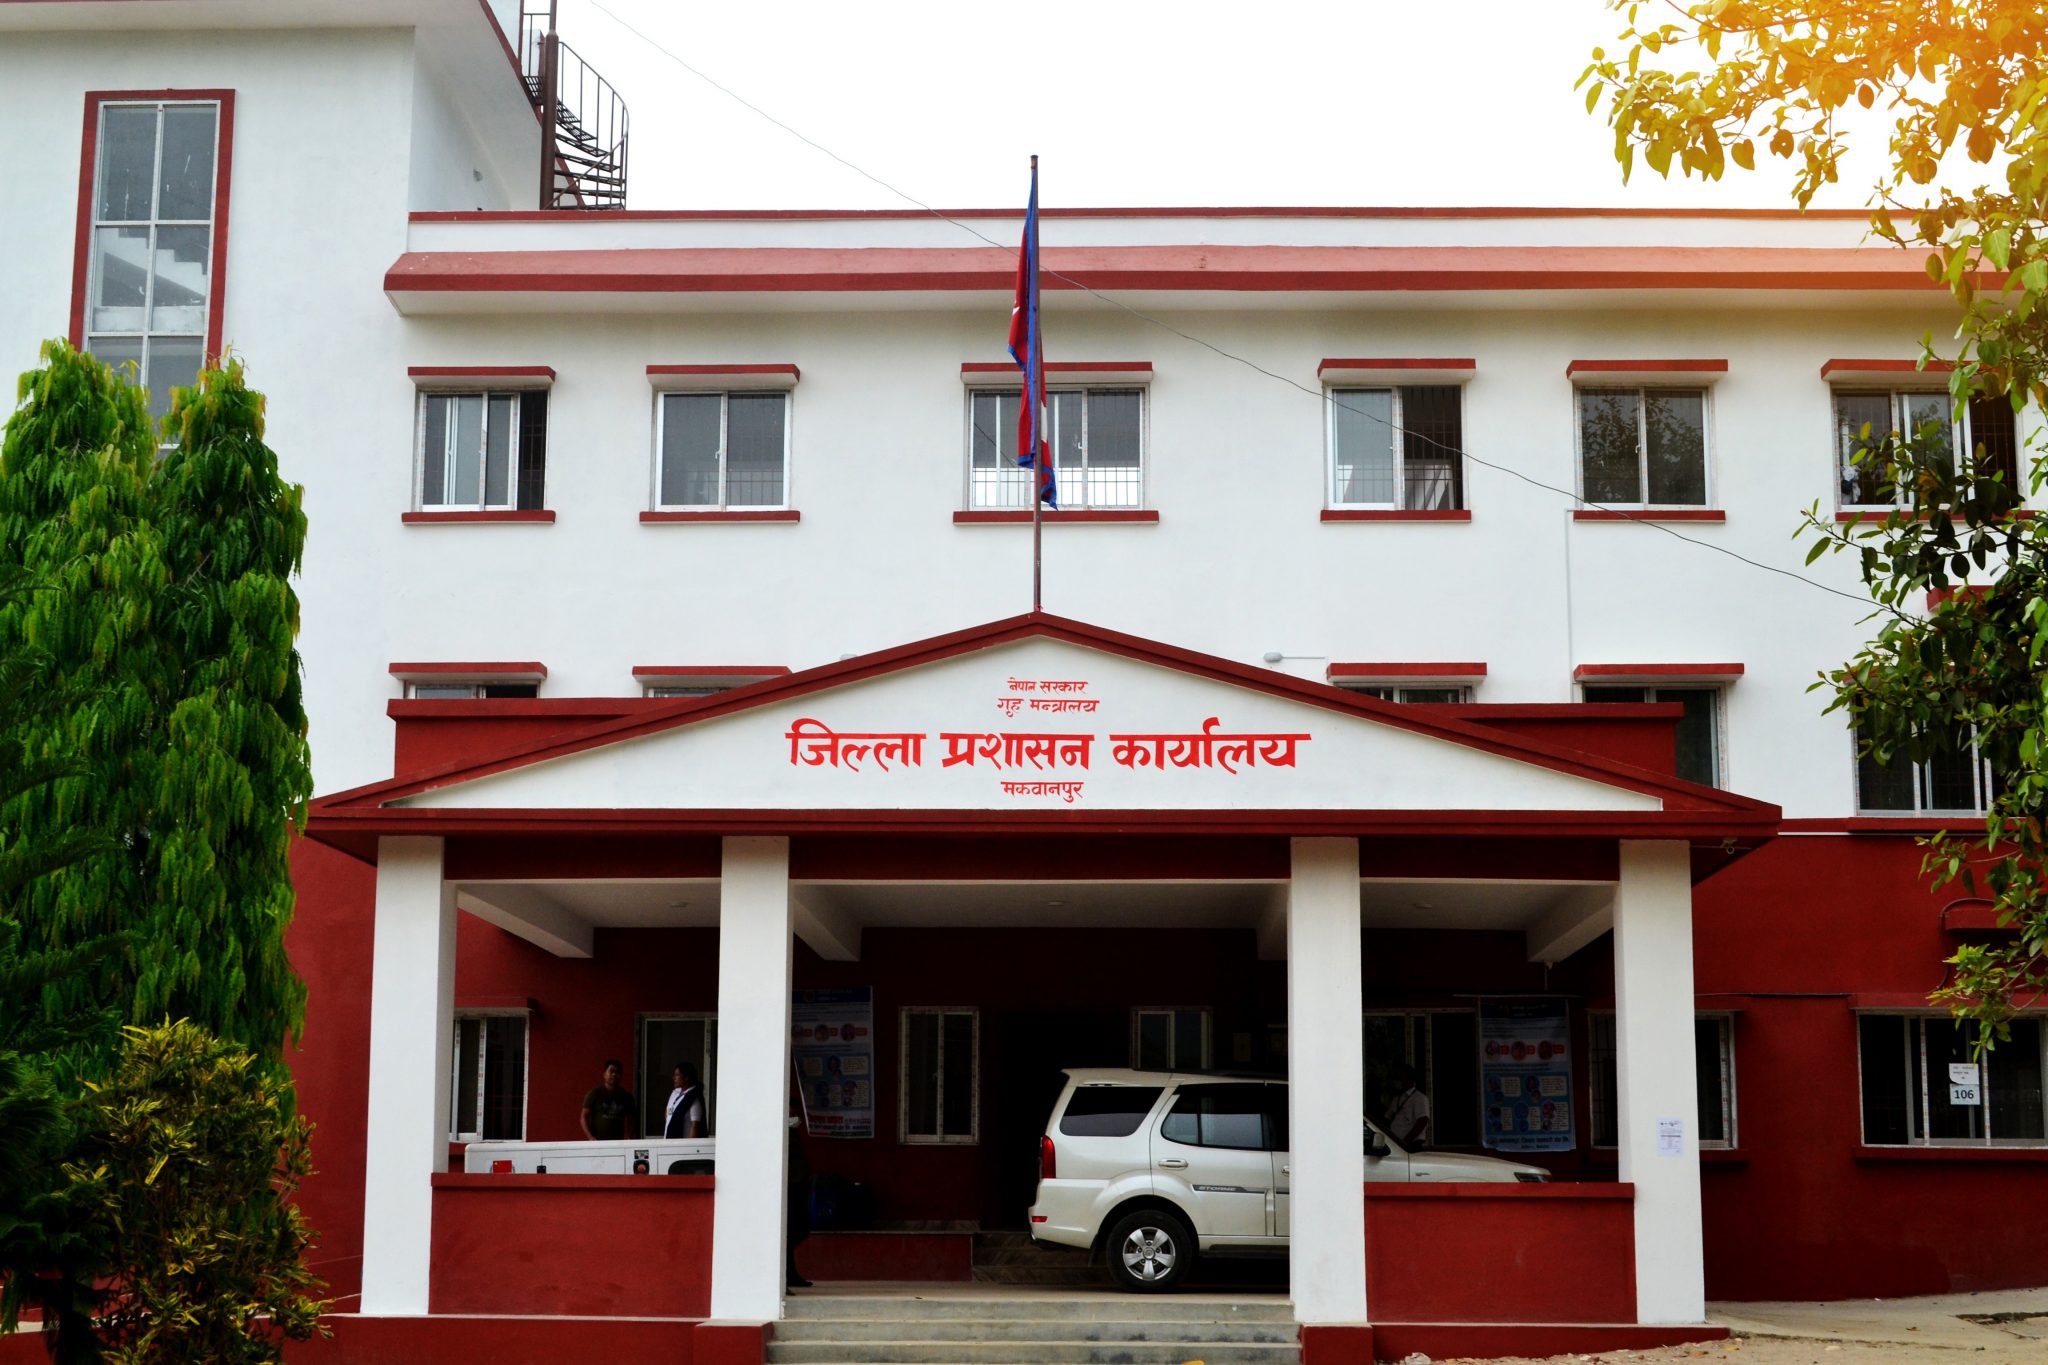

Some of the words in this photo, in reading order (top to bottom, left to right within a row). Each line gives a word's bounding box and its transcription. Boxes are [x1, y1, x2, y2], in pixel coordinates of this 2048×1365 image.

[1007, 676, 1037, 692] नेपाल
[1040, 681, 1089, 695] सरकार
[997, 698, 1024, 717] गृह
[1029, 699, 1100, 713] मन्त्रालय
[785, 717, 927, 773] जिल्ला
[939, 732, 1095, 771] प्रशासन
[1108, 716, 1312, 775] कार्यालय
[1000, 781, 1084, 803] मकवानपुर
[1954, 1089, 1974, 1099] 106
